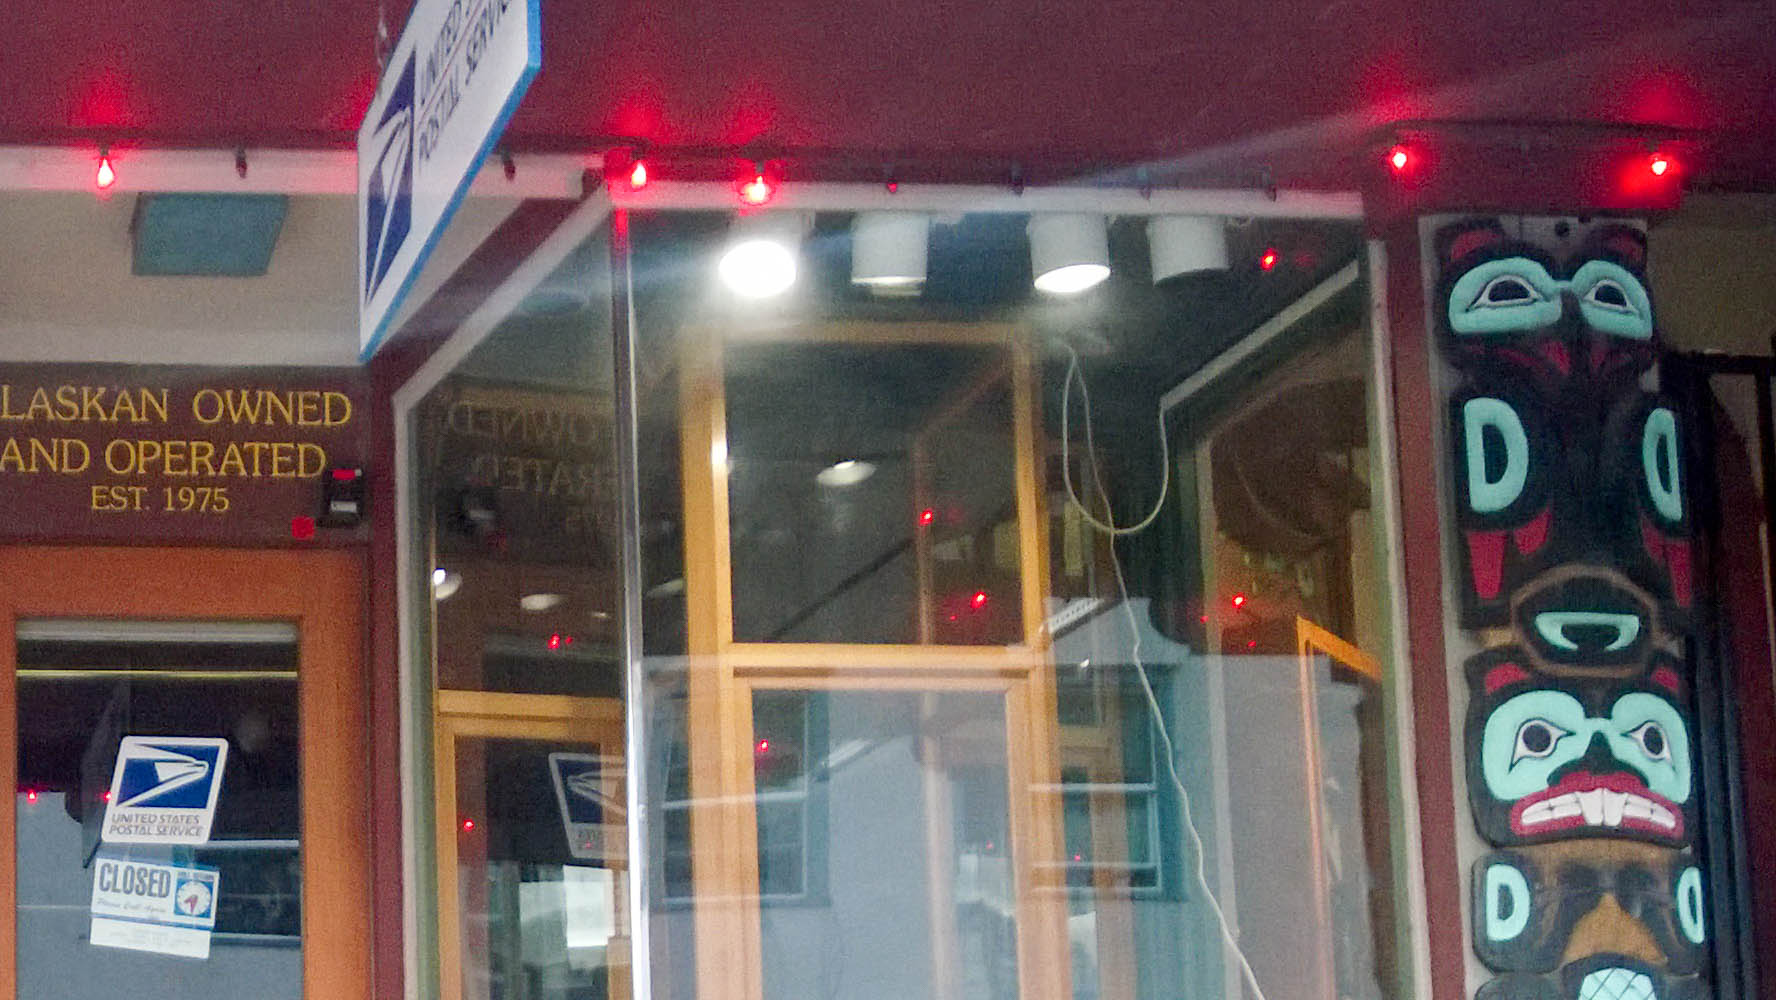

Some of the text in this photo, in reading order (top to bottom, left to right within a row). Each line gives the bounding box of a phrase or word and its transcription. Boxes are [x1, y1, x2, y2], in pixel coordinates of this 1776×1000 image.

[193, 388, 352, 426] OWNED
[105, 439, 326, 479] OPERATED
[91, 485, 230, 513] EST. 1975
[109, 825, 204, 837] POSTAL SERVICE
[111, 813, 200, 825] UNITED STATES
[99, 862, 172, 899] CLOSED
